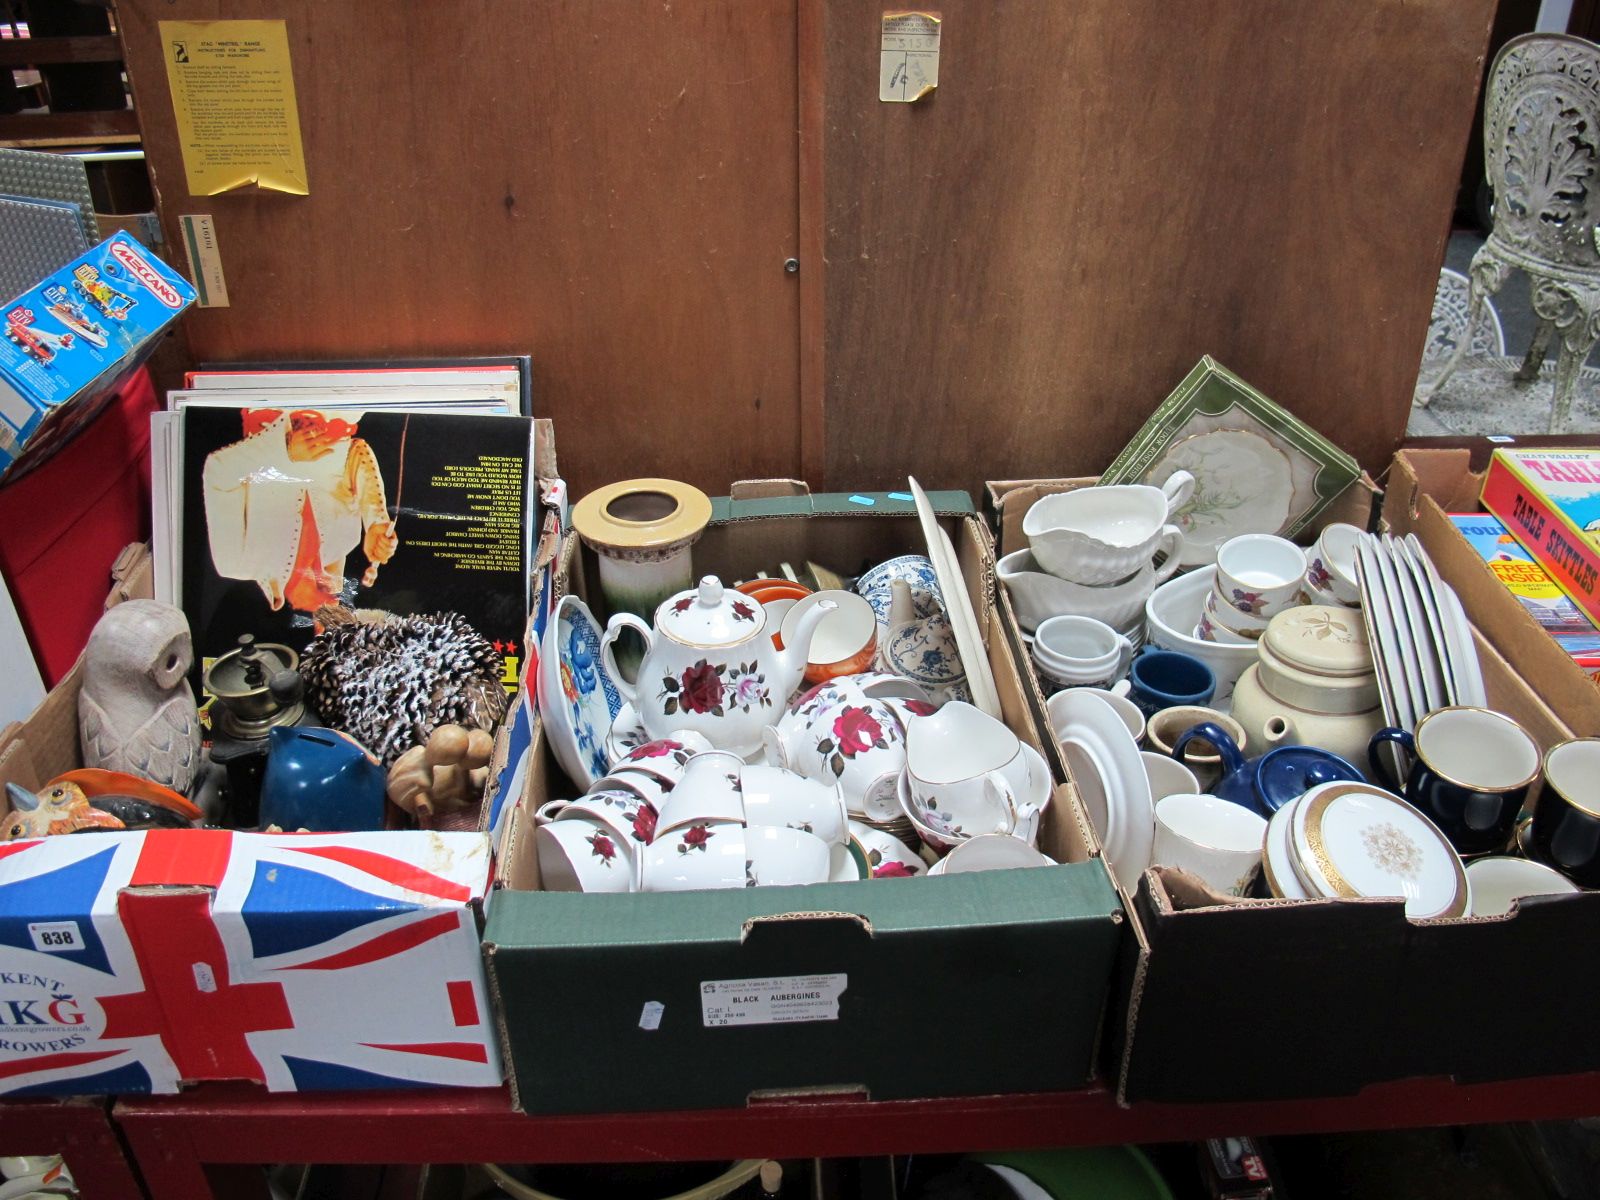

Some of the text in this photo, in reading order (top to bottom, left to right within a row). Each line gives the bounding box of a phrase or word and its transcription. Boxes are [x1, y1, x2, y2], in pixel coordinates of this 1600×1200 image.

[113, 249, 178, 303] MECCANO
[47, 286, 64, 303] CITY
[12, 309, 32, 327] CITY
[1156, 425, 1175, 446] TUDOR
[1142, 446, 1157, 464] ROSE
[1128, 464, 1142, 480] DISH
[1513, 494, 1545, 541] TABLE
[1546, 529, 1598, 596] SKITTLES
[1491, 564, 1542, 574] FREE
[41, 931, 74, 945] 838
[0, 972, 65, 992] KENT
[732, 992, 821, 1004] BLACK AUBERGINES
[1244, 1156, 1261, 1177] TV
